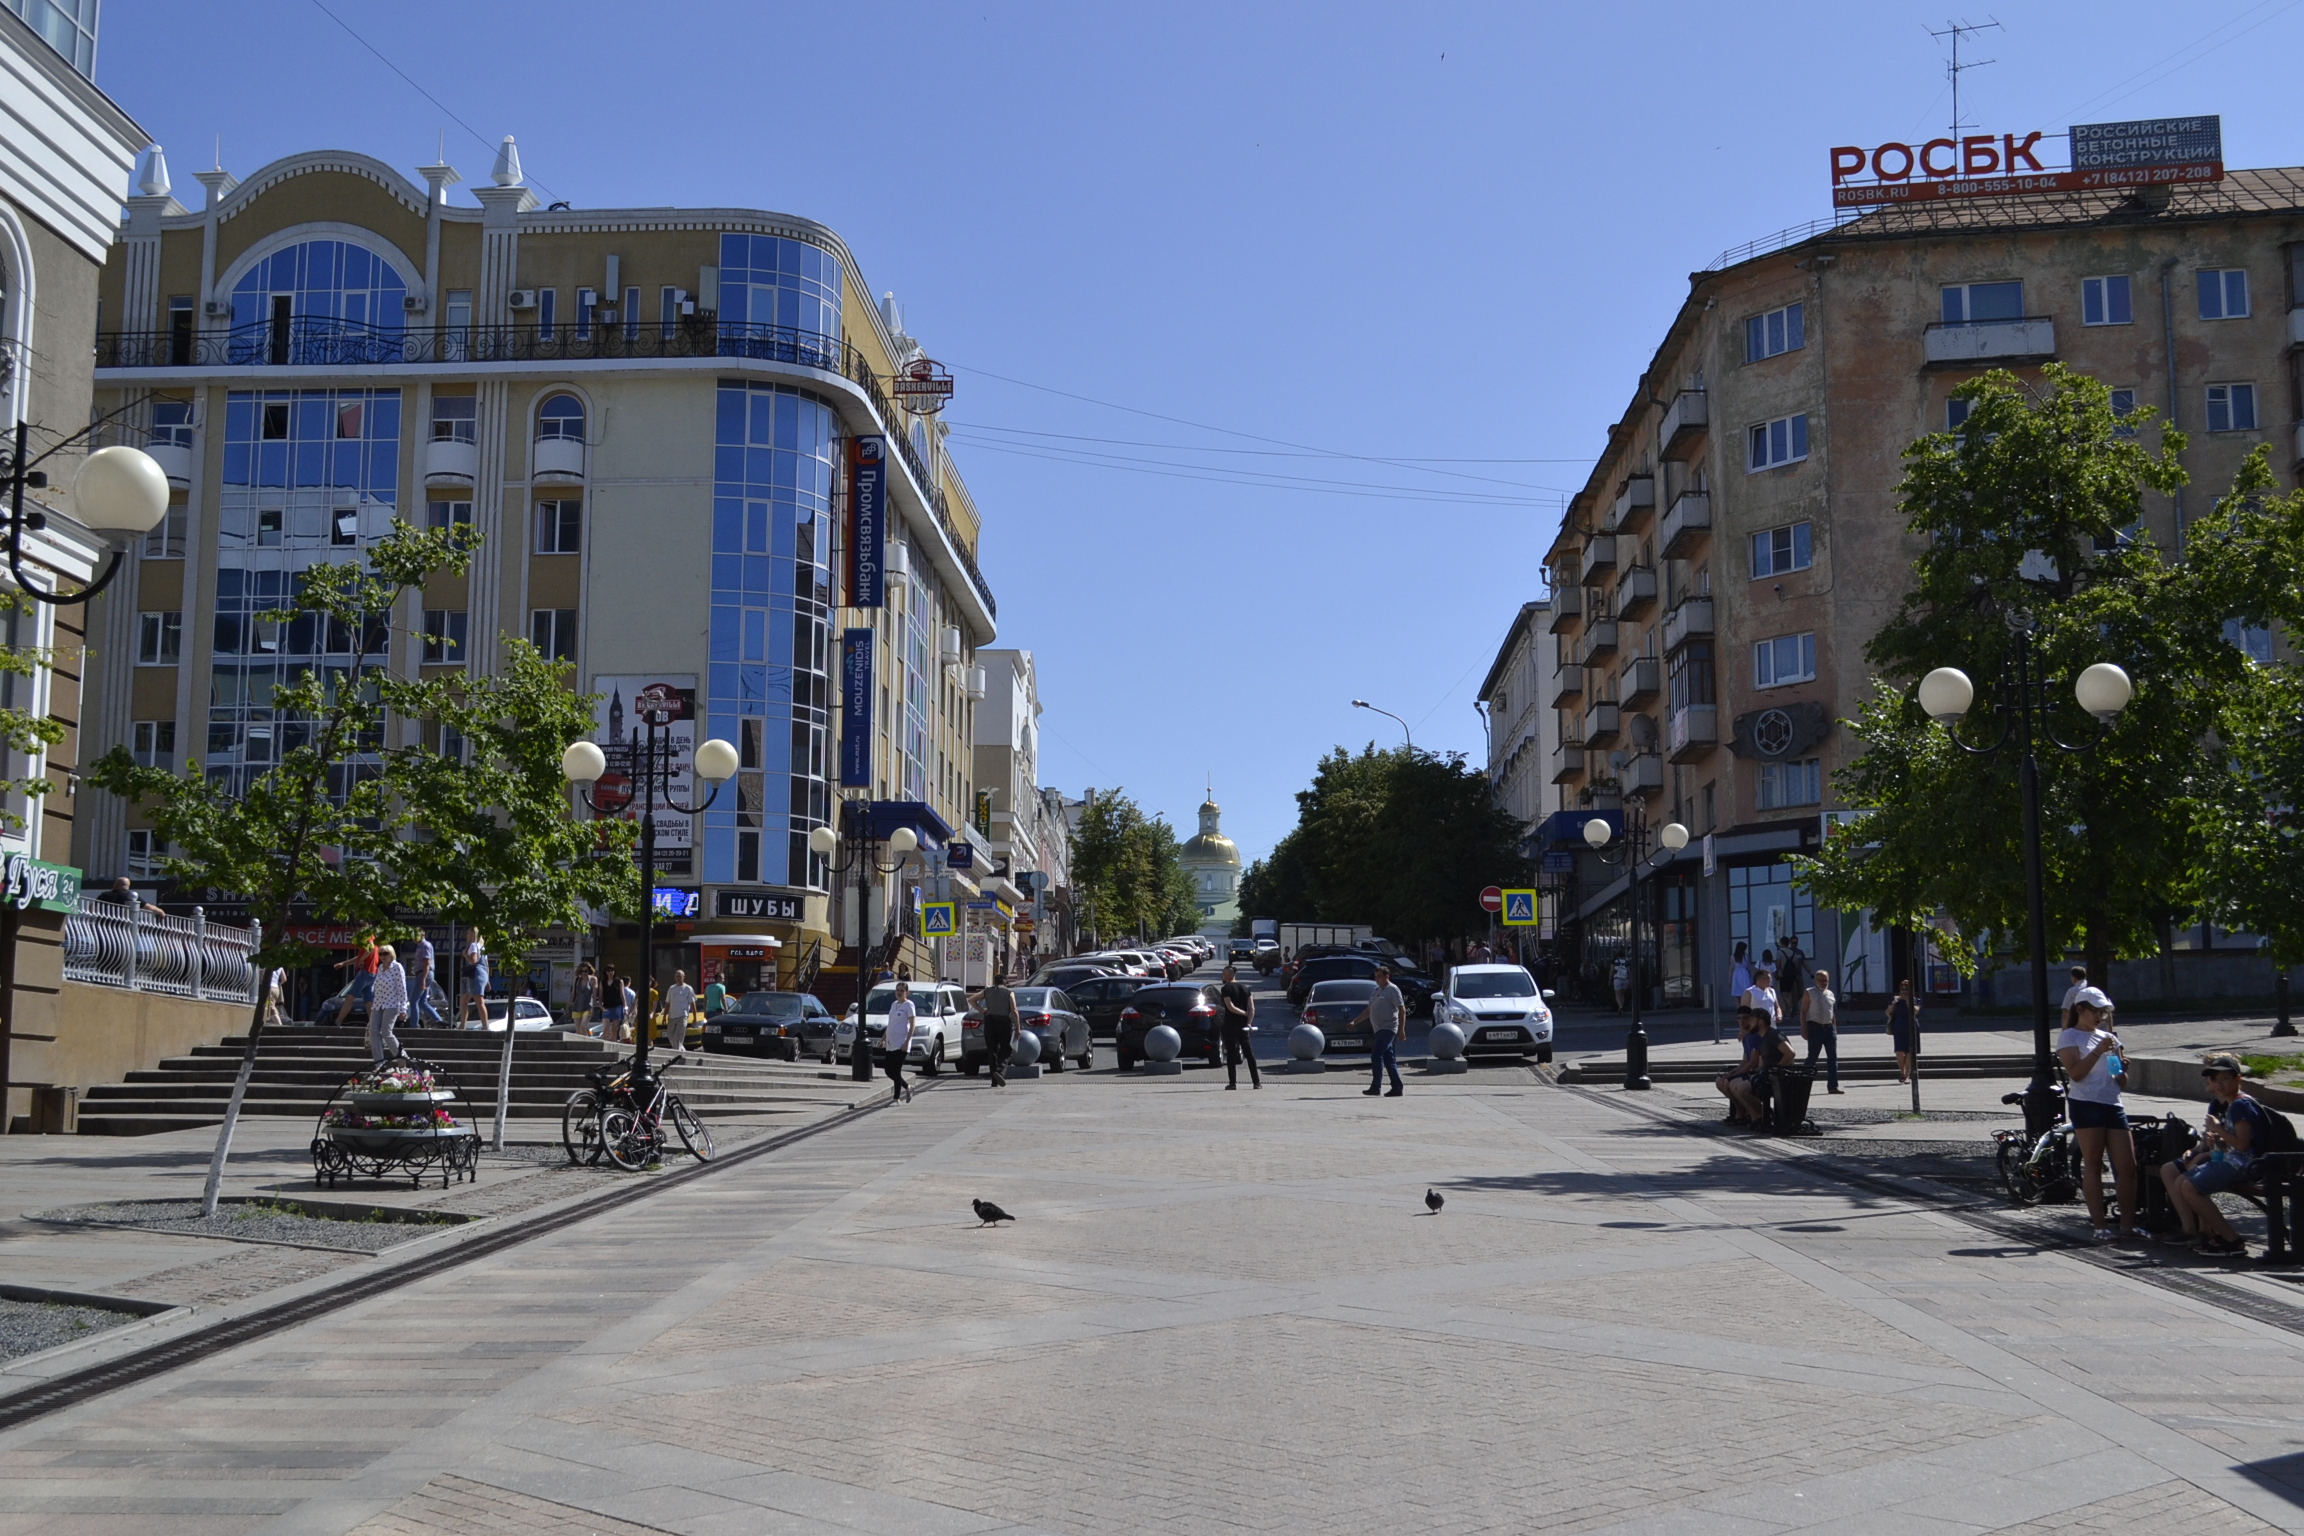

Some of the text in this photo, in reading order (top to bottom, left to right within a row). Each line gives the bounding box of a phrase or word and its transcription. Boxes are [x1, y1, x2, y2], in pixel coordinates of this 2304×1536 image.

[2075, 120, 2203, 139] РОССИЙСКИЕ
[2077, 134, 2179, 153] БЕТОННЫЕ
[1830, 131, 2044, 186] РОСБК
[2078, 146, 2216, 166] КОНСТРУКЦИИ
[1837, 166, 2212, 202] ROSBK.RU 8-800-555-10-04 +7 (8412) 207-208
[894, 382, 952, 392] BASKERVILLE
[907, 395, 938, 410] PUB
[857, 471, 876, 603] Промсвязьбанк
[854, 640, 864, 716] MOUZENIDIS
[62, 879, 74, 894] 24
[731, 898, 795, 917] ШУБЫ
